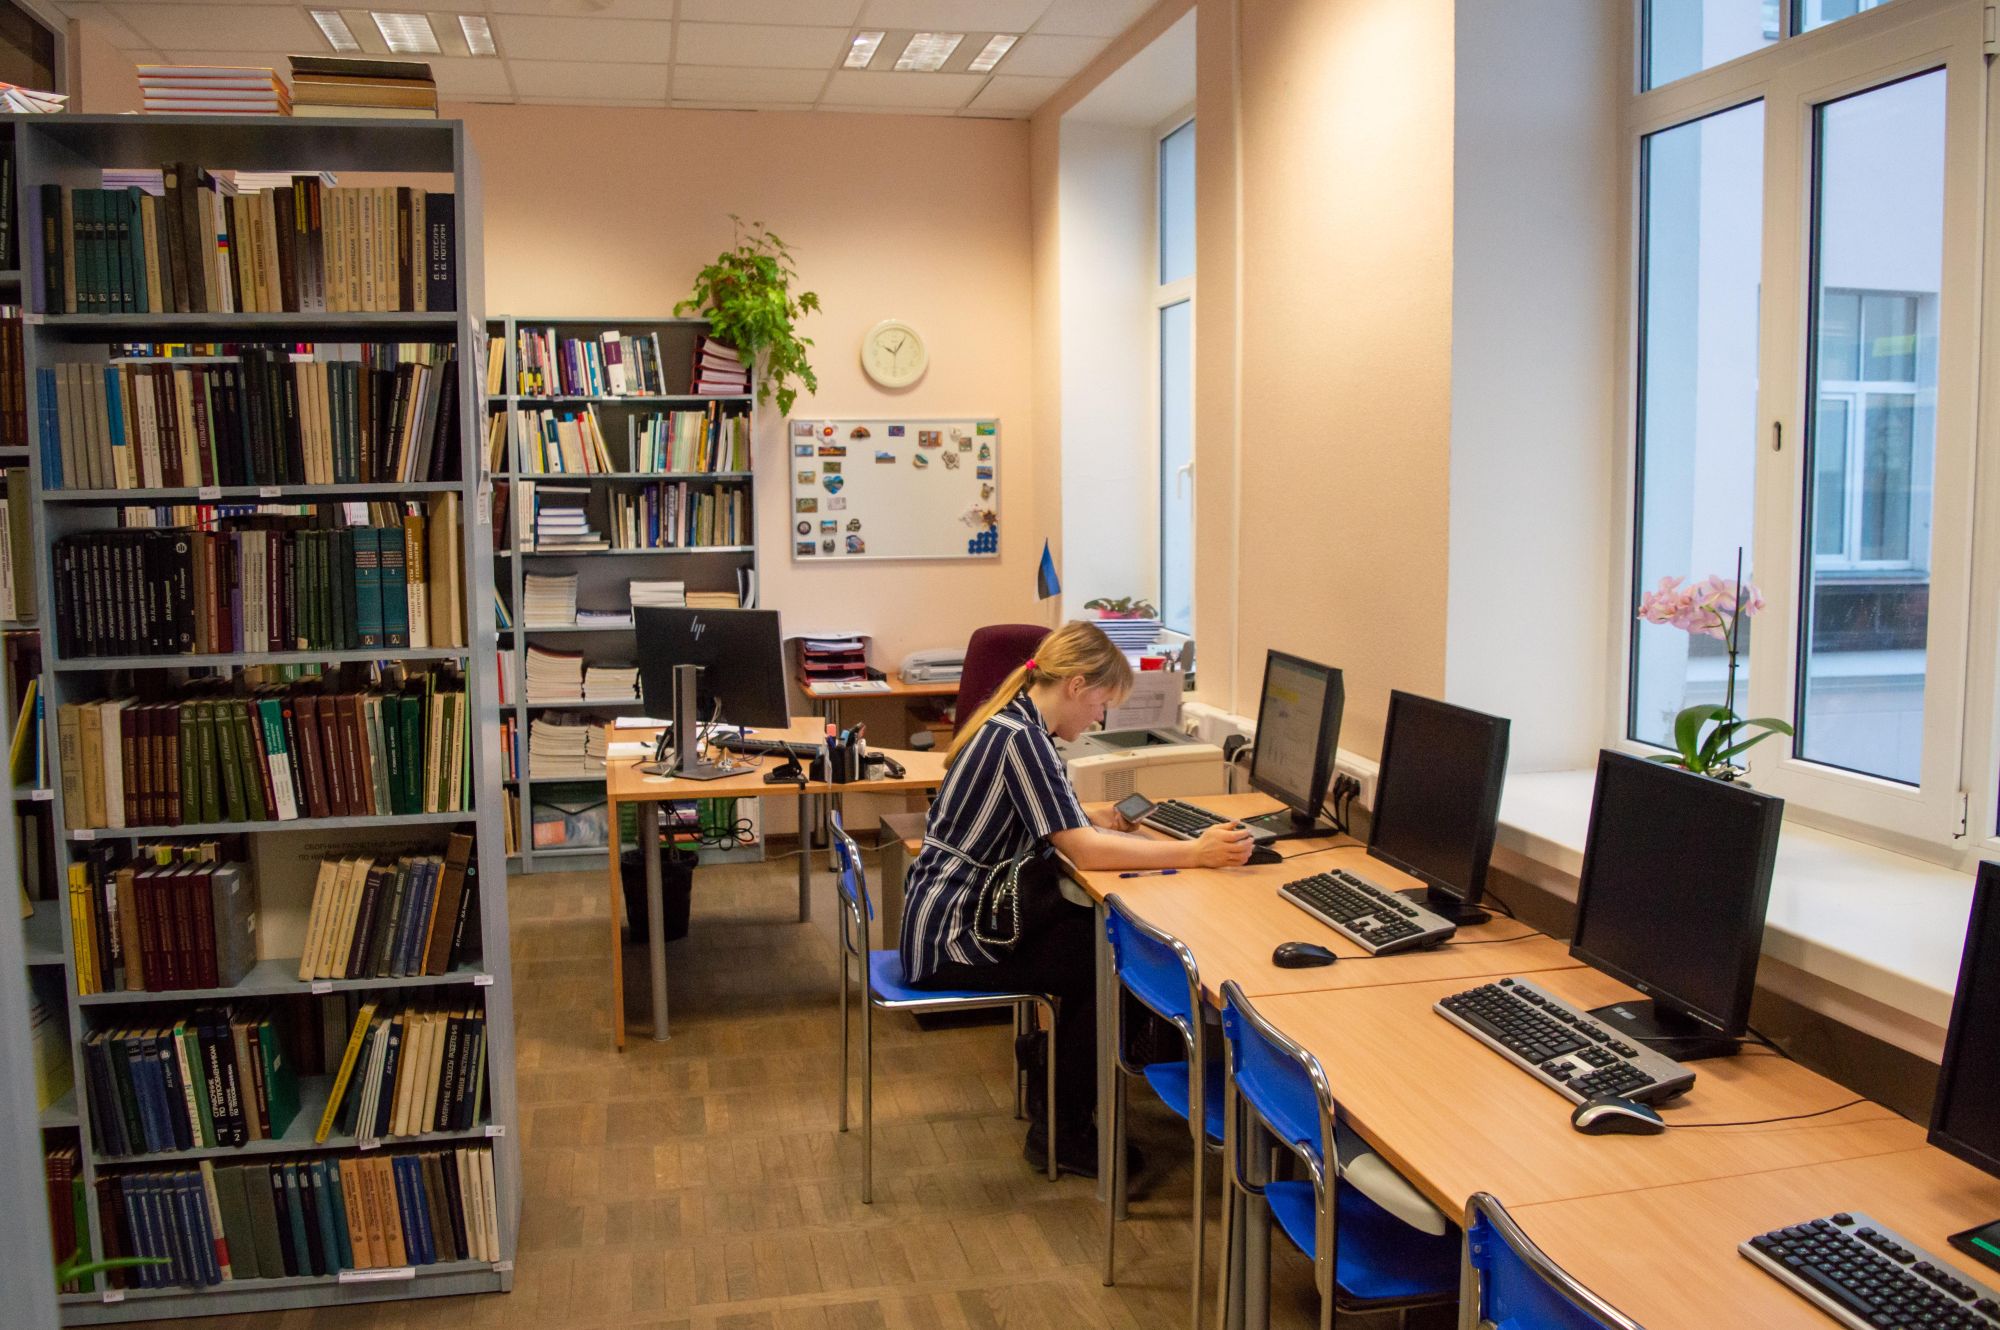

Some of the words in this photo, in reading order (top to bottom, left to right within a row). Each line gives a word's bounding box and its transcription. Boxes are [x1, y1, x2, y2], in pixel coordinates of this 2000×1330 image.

[690, 616, 706, 640] hp
[209, 1044, 224, 1104] ТЕПЛООБМЕННИКАМ
[208, 1079, 220, 1117] СПРАВОЧНИК
[220, 1107, 226, 1116] ПО
[234, 1133, 241, 1141] 2
